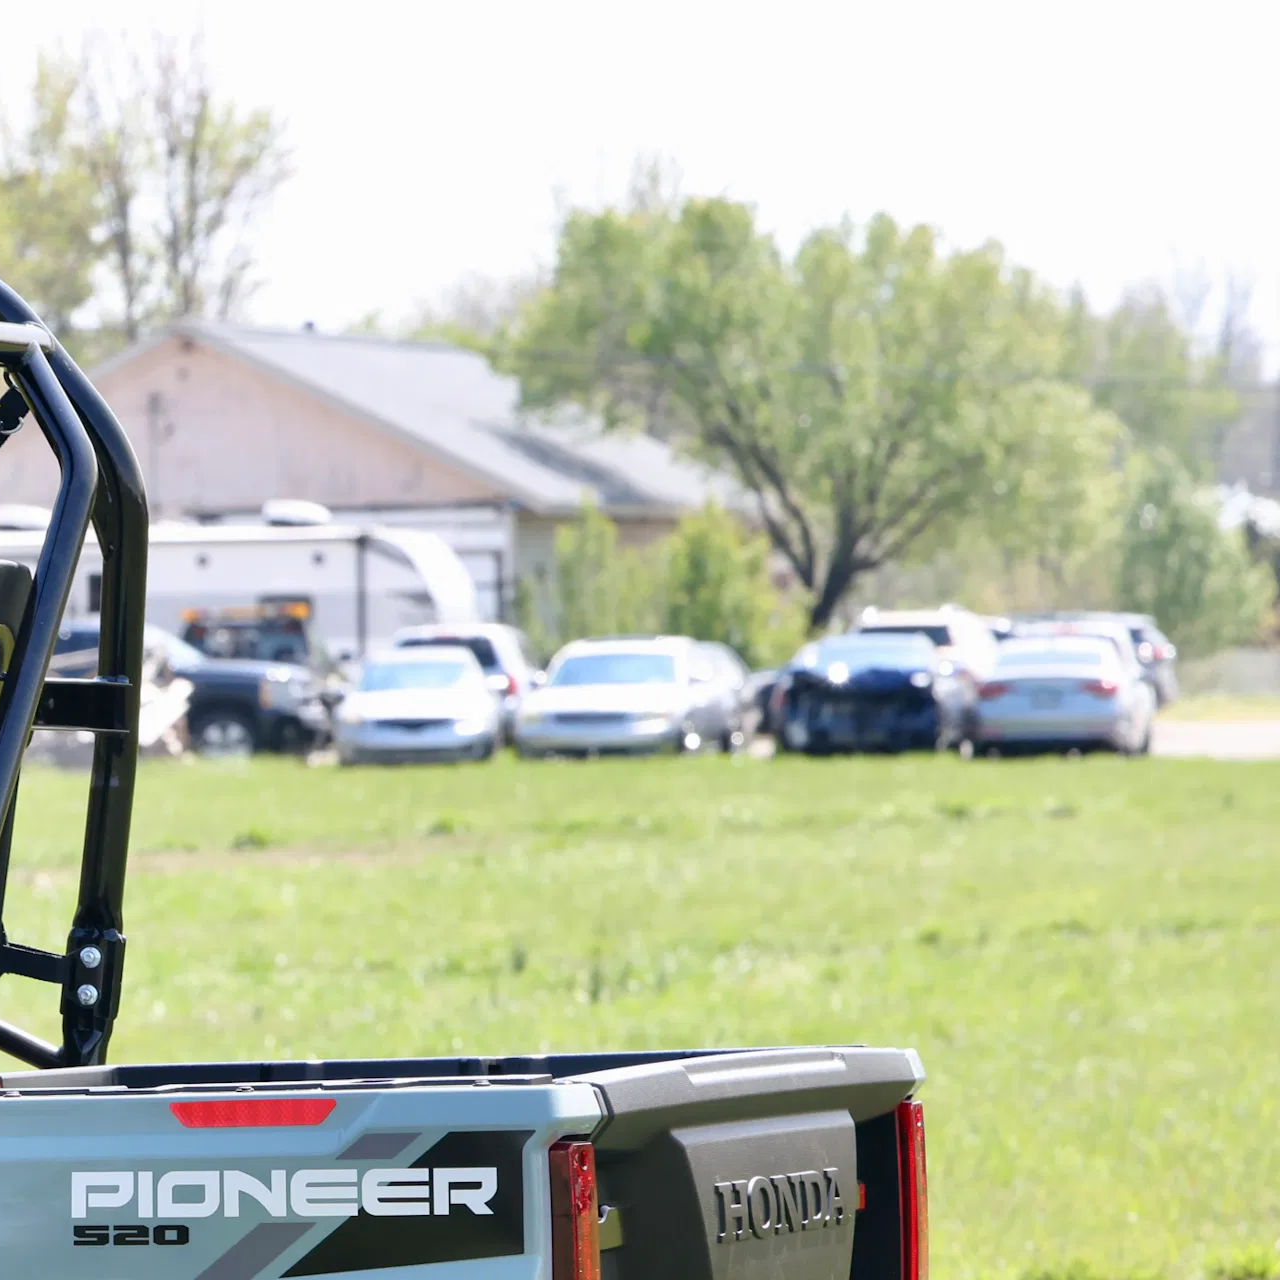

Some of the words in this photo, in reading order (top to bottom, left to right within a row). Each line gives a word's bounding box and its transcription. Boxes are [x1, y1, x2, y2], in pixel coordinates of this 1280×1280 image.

[71, 1168, 498, 1218] PIONEER
[714, 1167, 852, 1244] HONDA
[73, 1225, 189, 1246] 520
